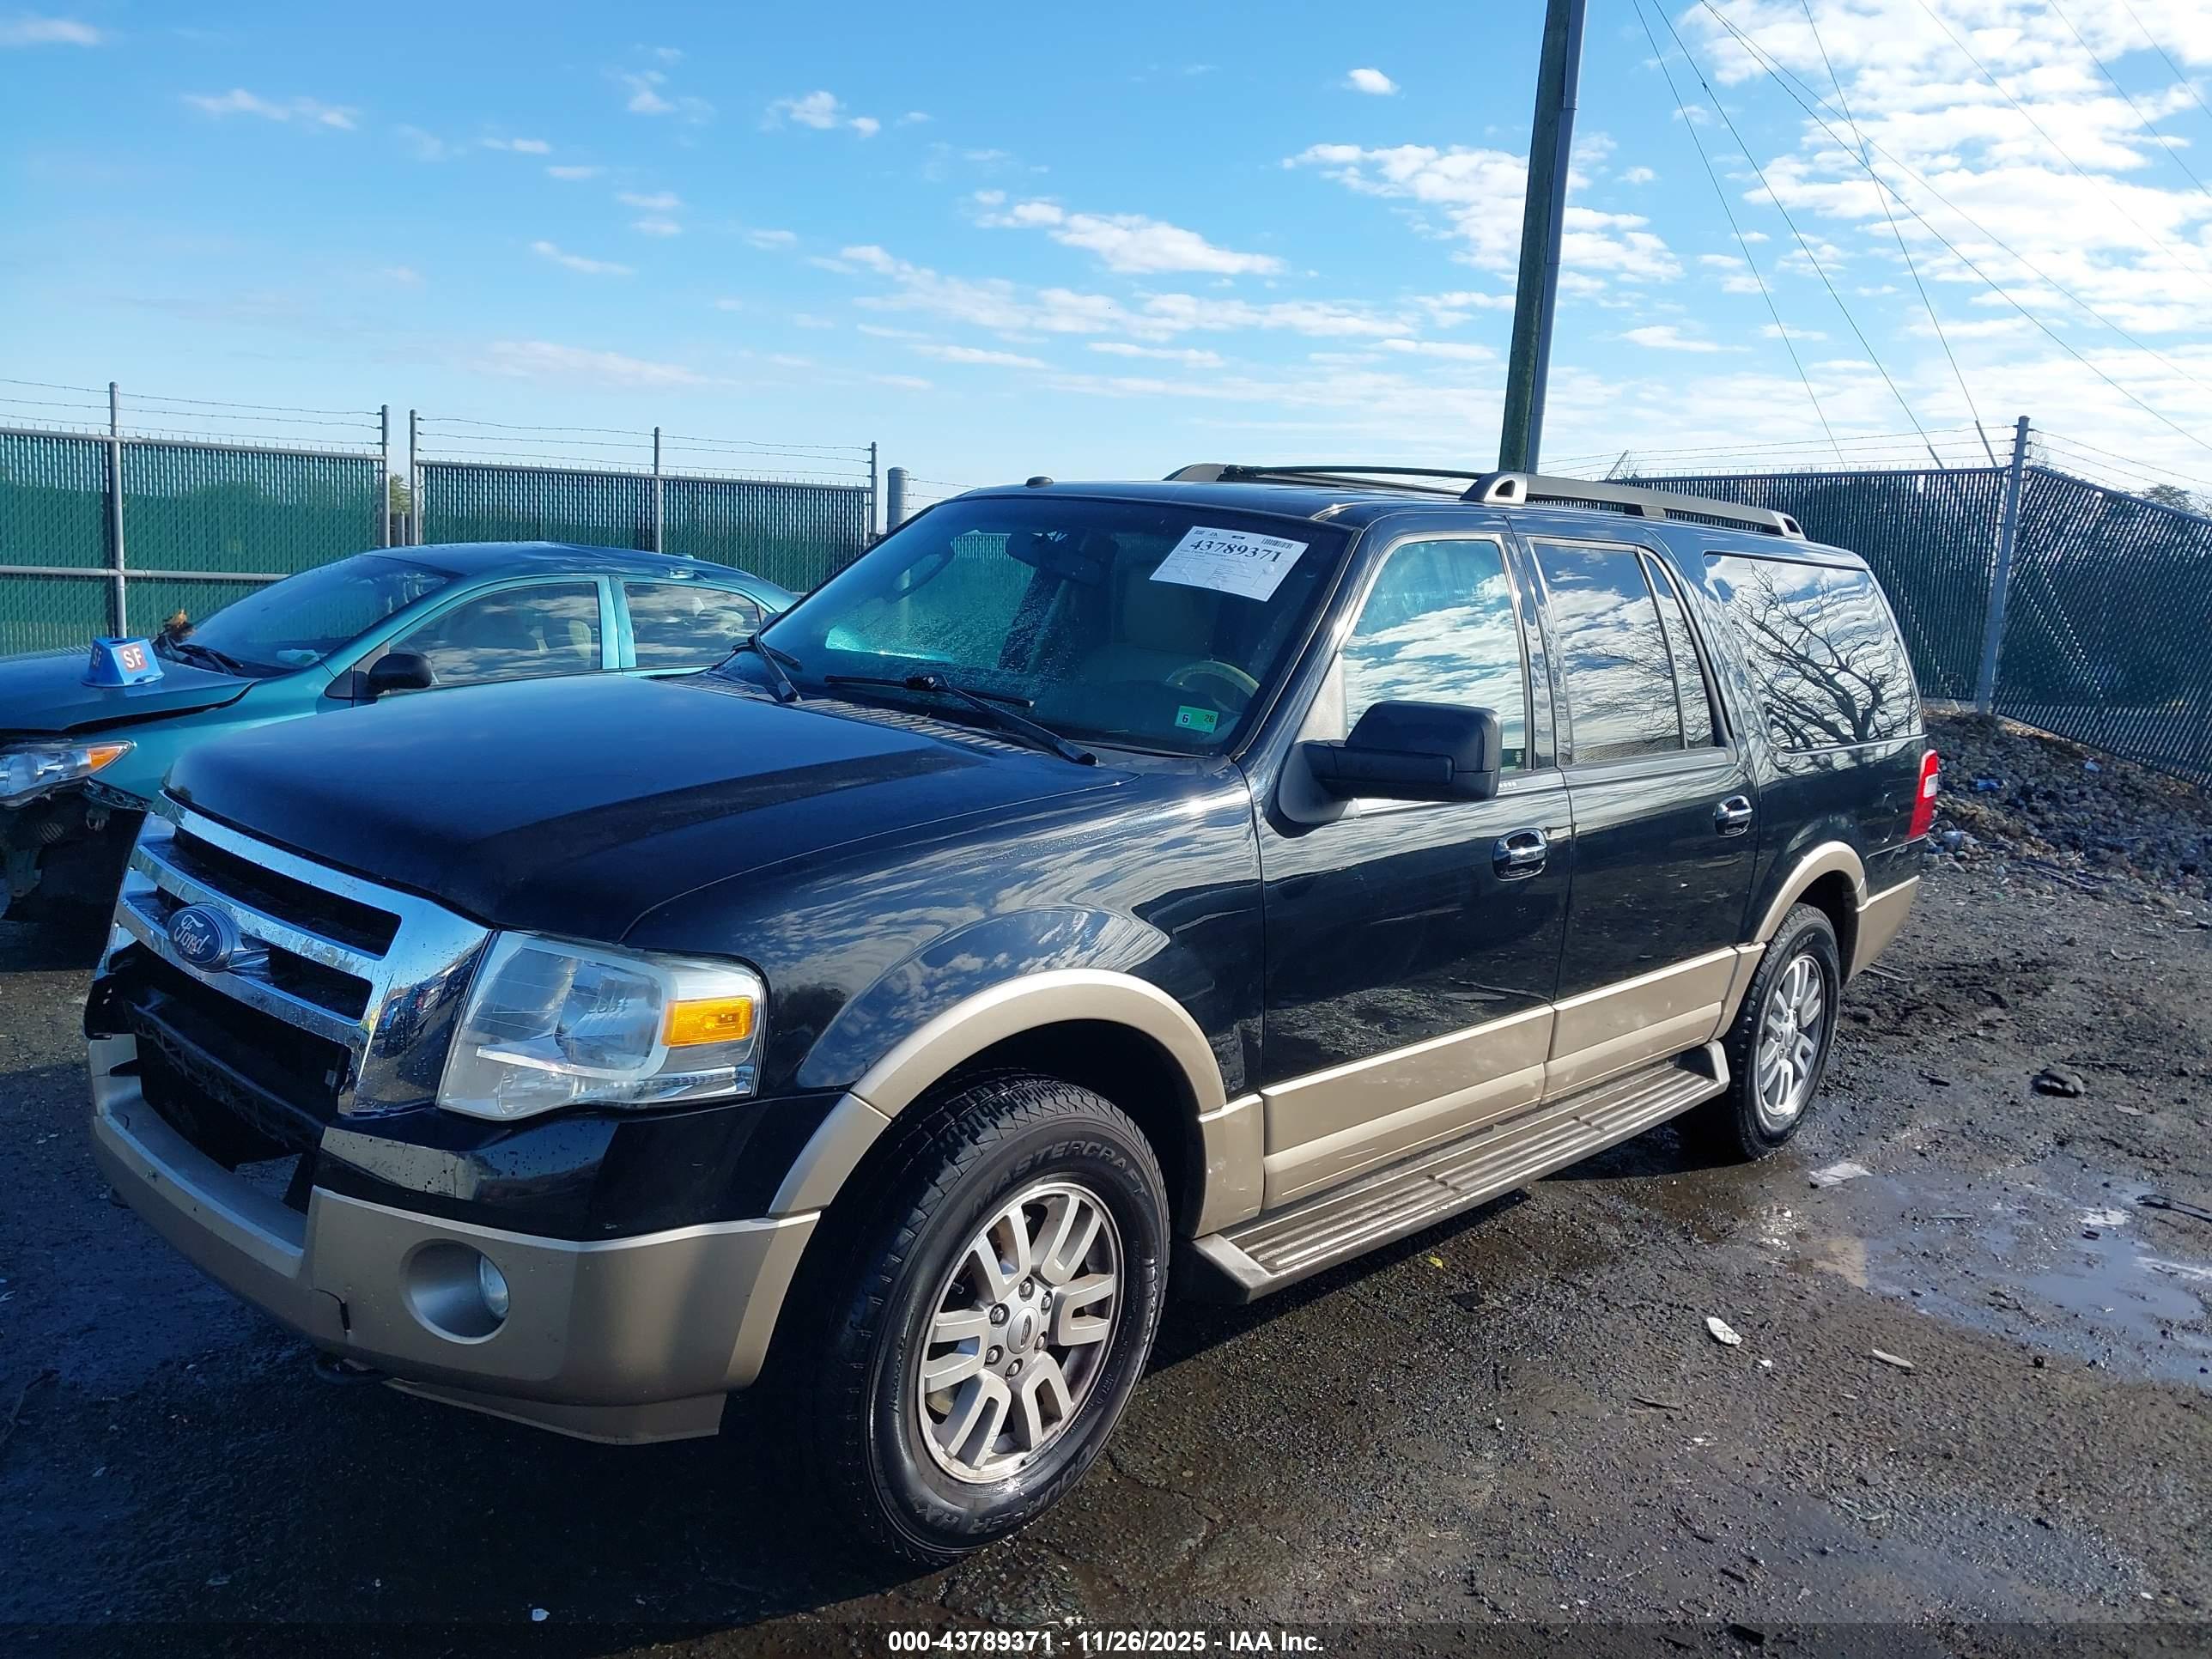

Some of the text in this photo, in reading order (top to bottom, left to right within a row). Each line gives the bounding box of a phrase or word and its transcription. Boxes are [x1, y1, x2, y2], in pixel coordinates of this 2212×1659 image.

[1190, 539, 1282, 562] 43789371
[123, 647, 142, 669] SF
[1182, 714, 1215, 724] 6 26
[174, 914, 210, 955] Ford
